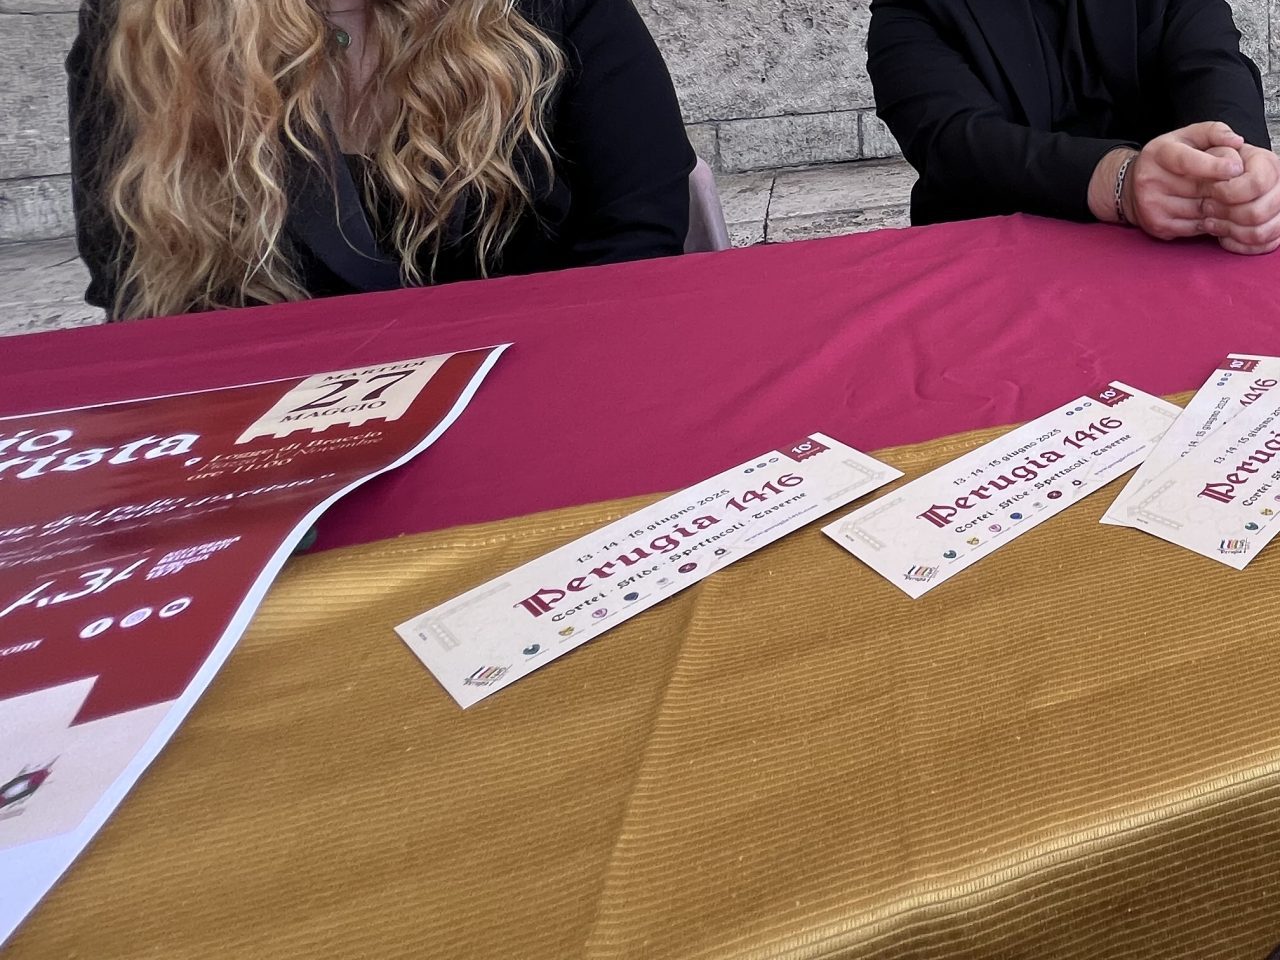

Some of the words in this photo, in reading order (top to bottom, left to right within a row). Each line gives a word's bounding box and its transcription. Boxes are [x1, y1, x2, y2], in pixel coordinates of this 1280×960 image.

[280, 400, 387, 423] MAGGIO
[287, 369, 417, 413] 27
[1004, 441, 1038, 462] giugno
[1036, 428, 1062, 442] 2025
[1247, 415, 1275, 439] giugno
[916, 449, 1066, 529] Perugia
[1063, 416, 1123, 450] 1416
[955, 510, 994, 533] Cortei
[1034, 457, 1089, 490] Spettacoli
[1242, 481, 1273, 507] Cortei
[512, 513, 722, 618] Perugia
[725, 472, 804, 513] 1416
[576, 553, 594, 564] 13
[602, 541, 619, 552] 14
[646, 505, 696, 531] giugno
[697, 489, 731, 506] 2025
[551, 591, 607, 622] Cortei
[616, 563, 661, 589] Sfide
[669, 522, 746, 562] Spettacoli
[751, 492, 807, 520] Taverne
